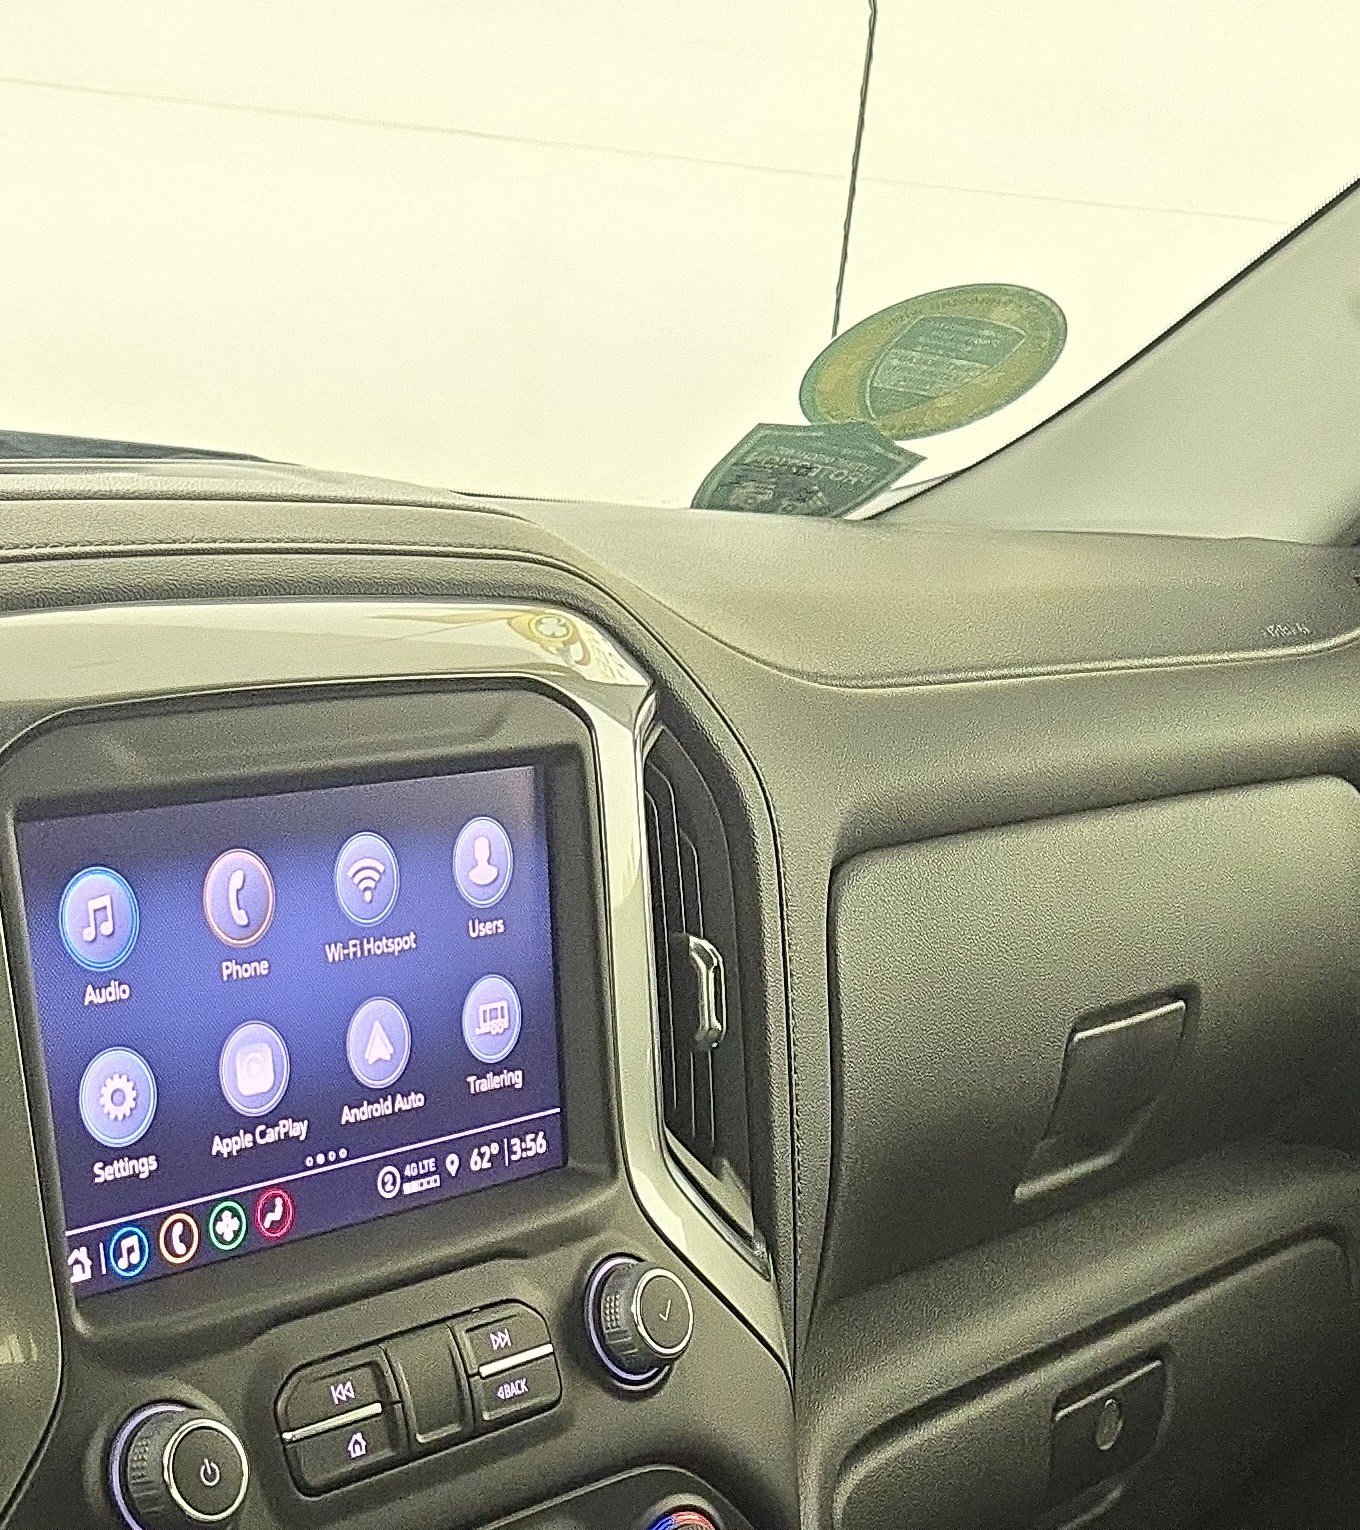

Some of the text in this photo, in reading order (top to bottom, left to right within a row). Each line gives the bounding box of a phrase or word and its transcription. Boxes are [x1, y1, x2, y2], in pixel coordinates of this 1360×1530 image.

[468, 919, 505, 938] Users
[325, 931, 417, 963] Wi-Fi Hotspot
[221, 959, 269, 981] Phone
[83, 980, 130, 1005] Audio
[466, 1069, 523, 1095] Trailering
[341, 1091, 425, 1125] Android Auto
[211, 1118, 309, 1158] Apple CarPlay
[403, 1161, 418, 1178] 4G
[418, 1157, 437, 1175] LTE
[510, 1131, 547, 1161] 3:56
[93, 1155, 158, 1183] Settings
[503, 1377, 529, 1399] BACK
